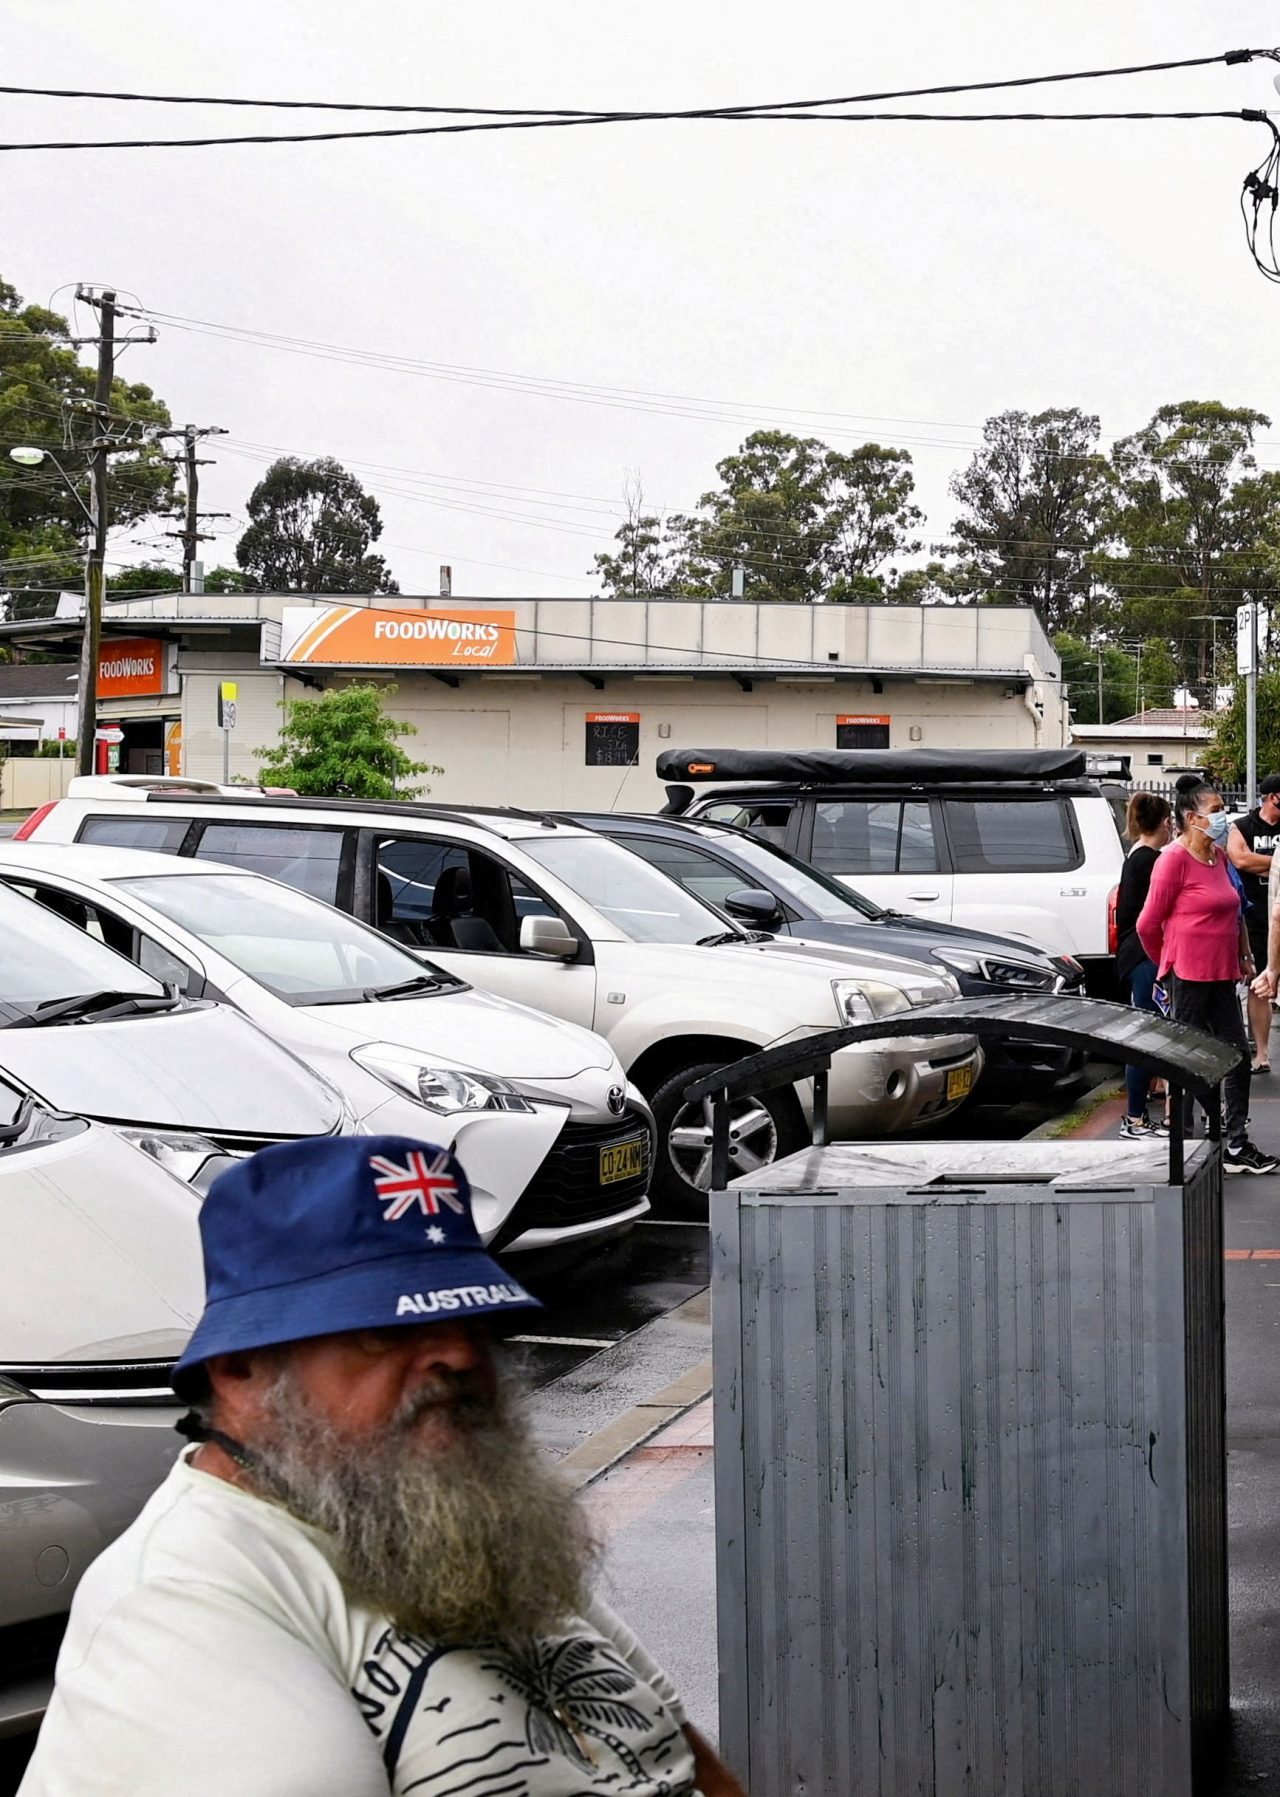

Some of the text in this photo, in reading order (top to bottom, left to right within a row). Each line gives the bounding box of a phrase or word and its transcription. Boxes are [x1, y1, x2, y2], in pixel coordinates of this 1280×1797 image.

[374, 620, 499, 640] FOODWORKS
[1239, 611, 1250, 630] 2P
[451, 641, 498, 657] Local
[100, 657, 154, 679] FOODWORKS
[396, 1284, 531, 1316] AUSTRALI
